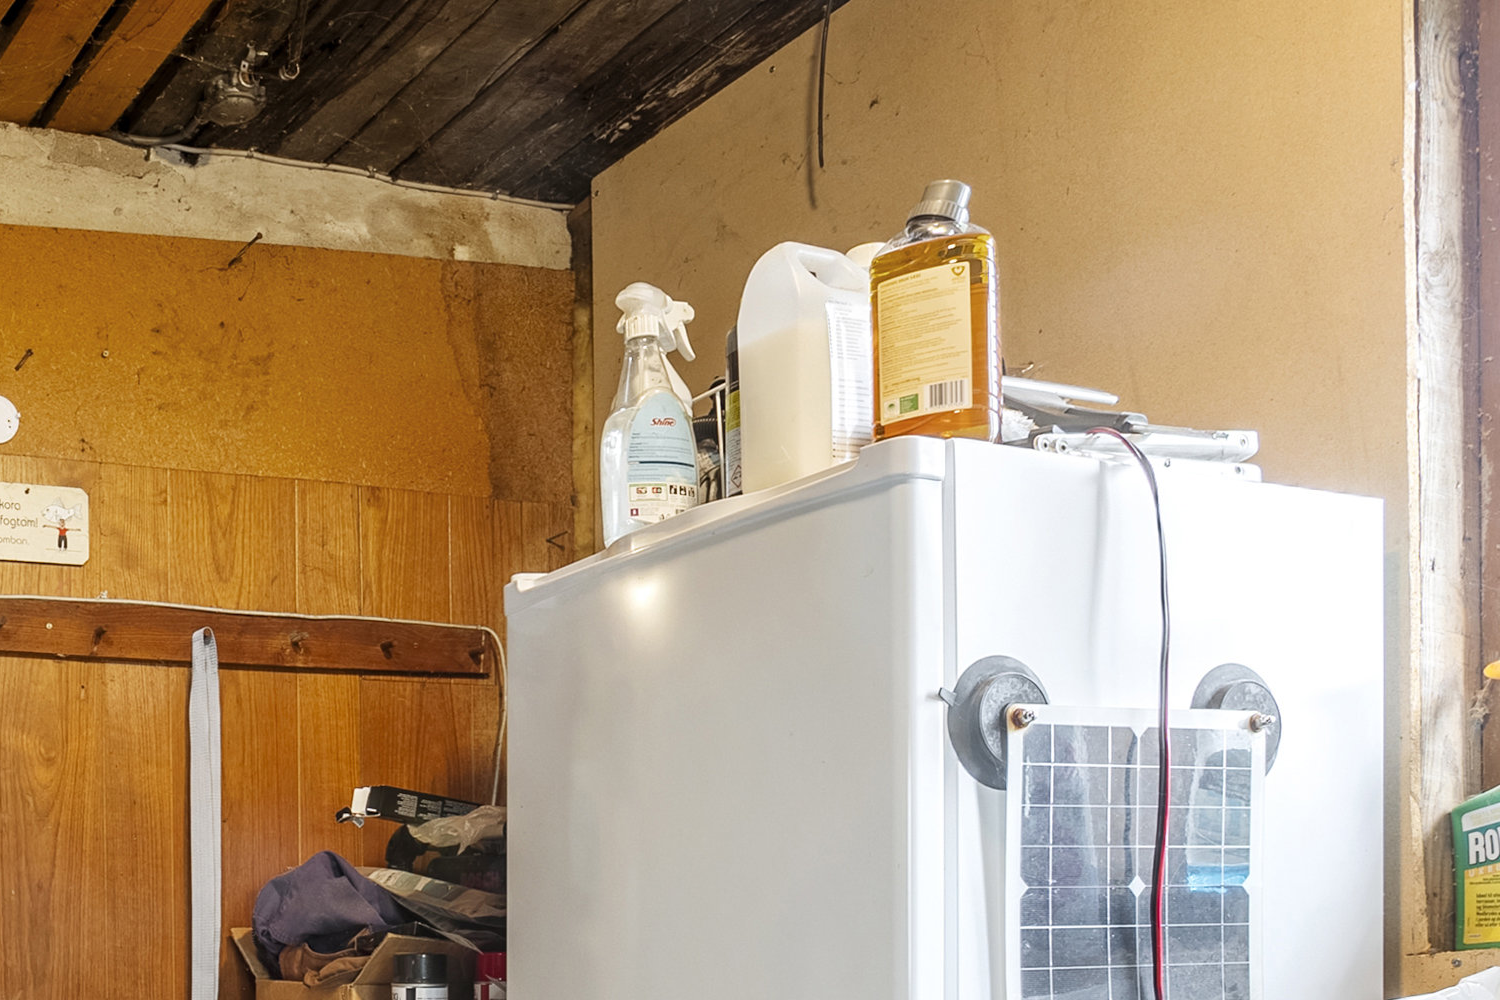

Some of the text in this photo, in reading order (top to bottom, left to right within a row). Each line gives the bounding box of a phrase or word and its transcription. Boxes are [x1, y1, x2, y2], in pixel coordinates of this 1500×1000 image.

[650, 417, 676, 427] Shine
[0, 515, 39, 529] fogtam!
[1468, 828, 1500, 865] RO
